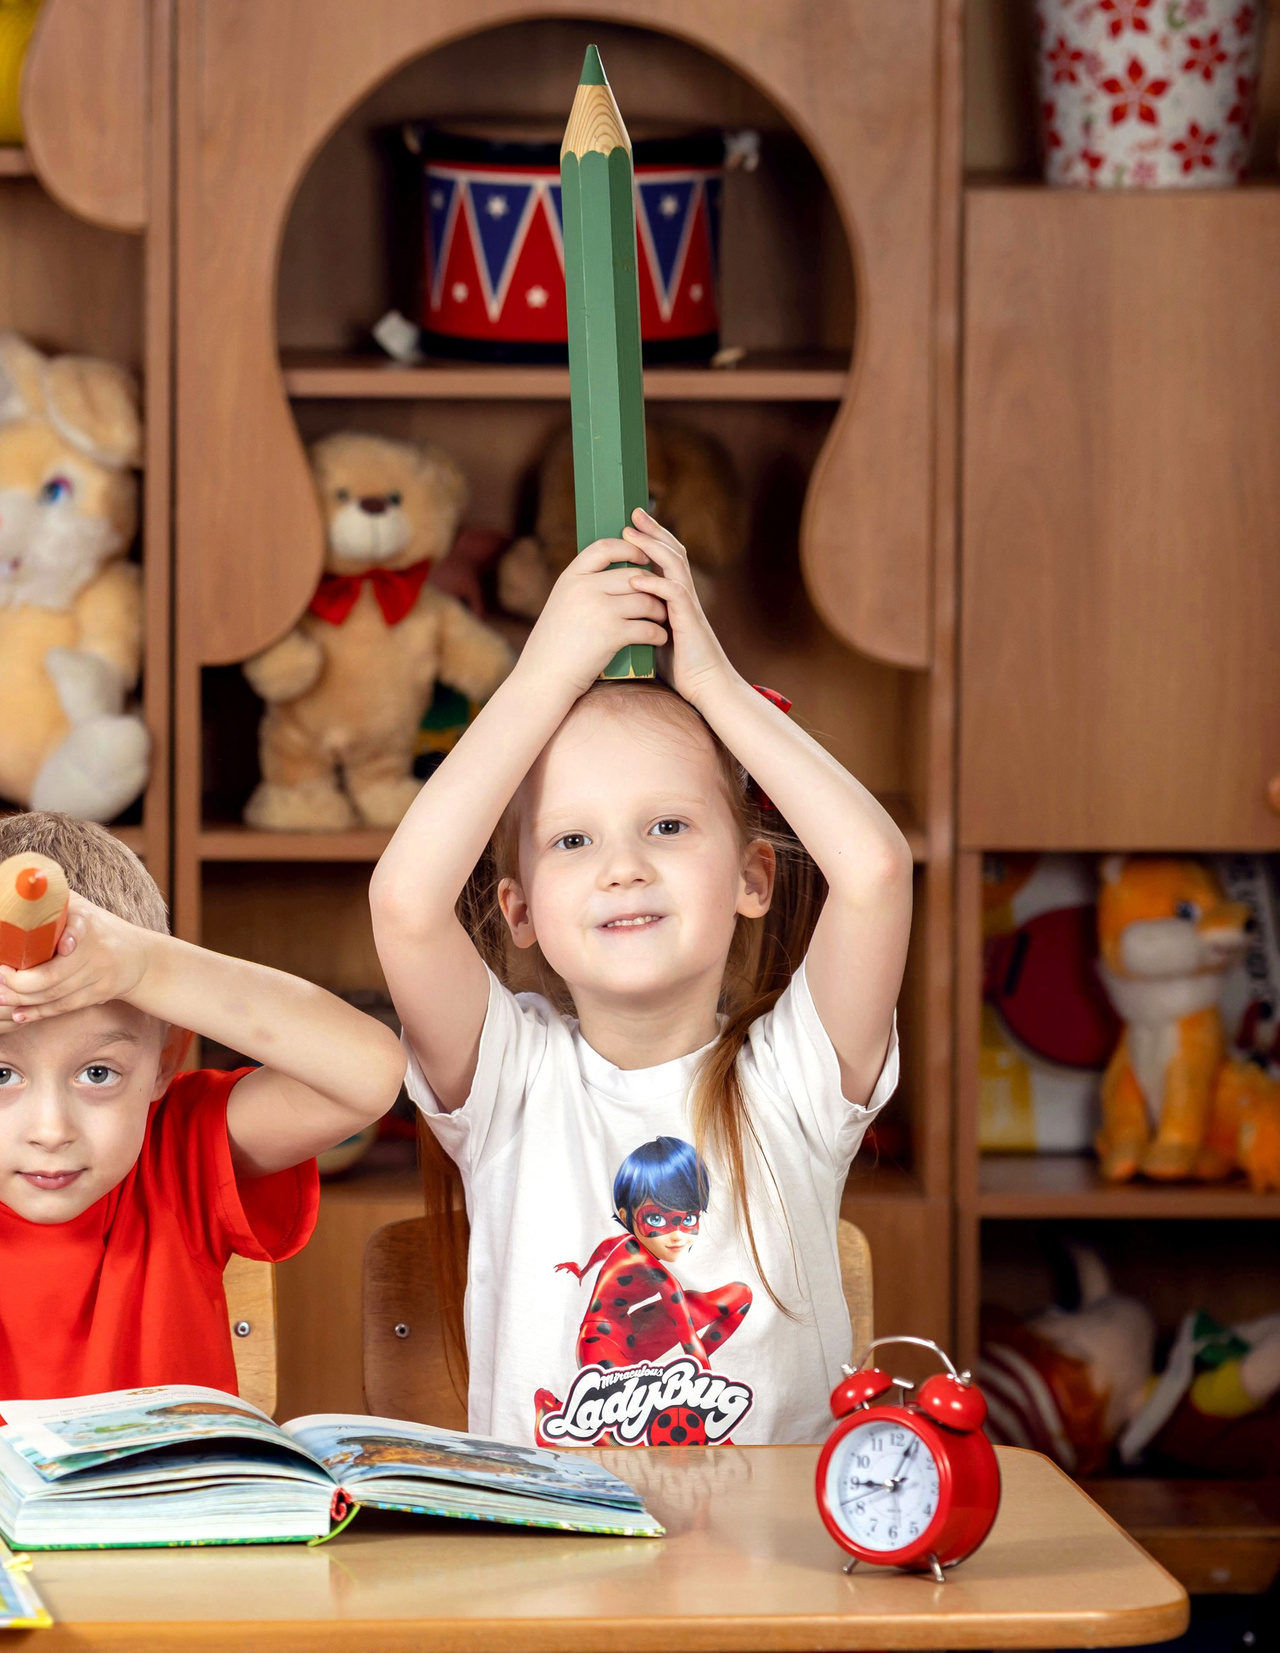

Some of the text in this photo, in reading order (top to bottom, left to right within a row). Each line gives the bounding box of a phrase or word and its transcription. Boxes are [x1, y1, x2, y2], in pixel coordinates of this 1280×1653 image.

[547, 1362, 750, 1439] LadyBug
[871, 1438, 883, 1452] 11
[890, 1433, 905, 1447] 12
[856, 1455, 870, 1469] 10
[856, 1500, 866, 1515] 8
[923, 1504, 932, 1517] 4
[869, 1518, 878, 1532] 7
[888, 1525, 898, 1539] 6
[909, 1522, 919, 1535] 5
